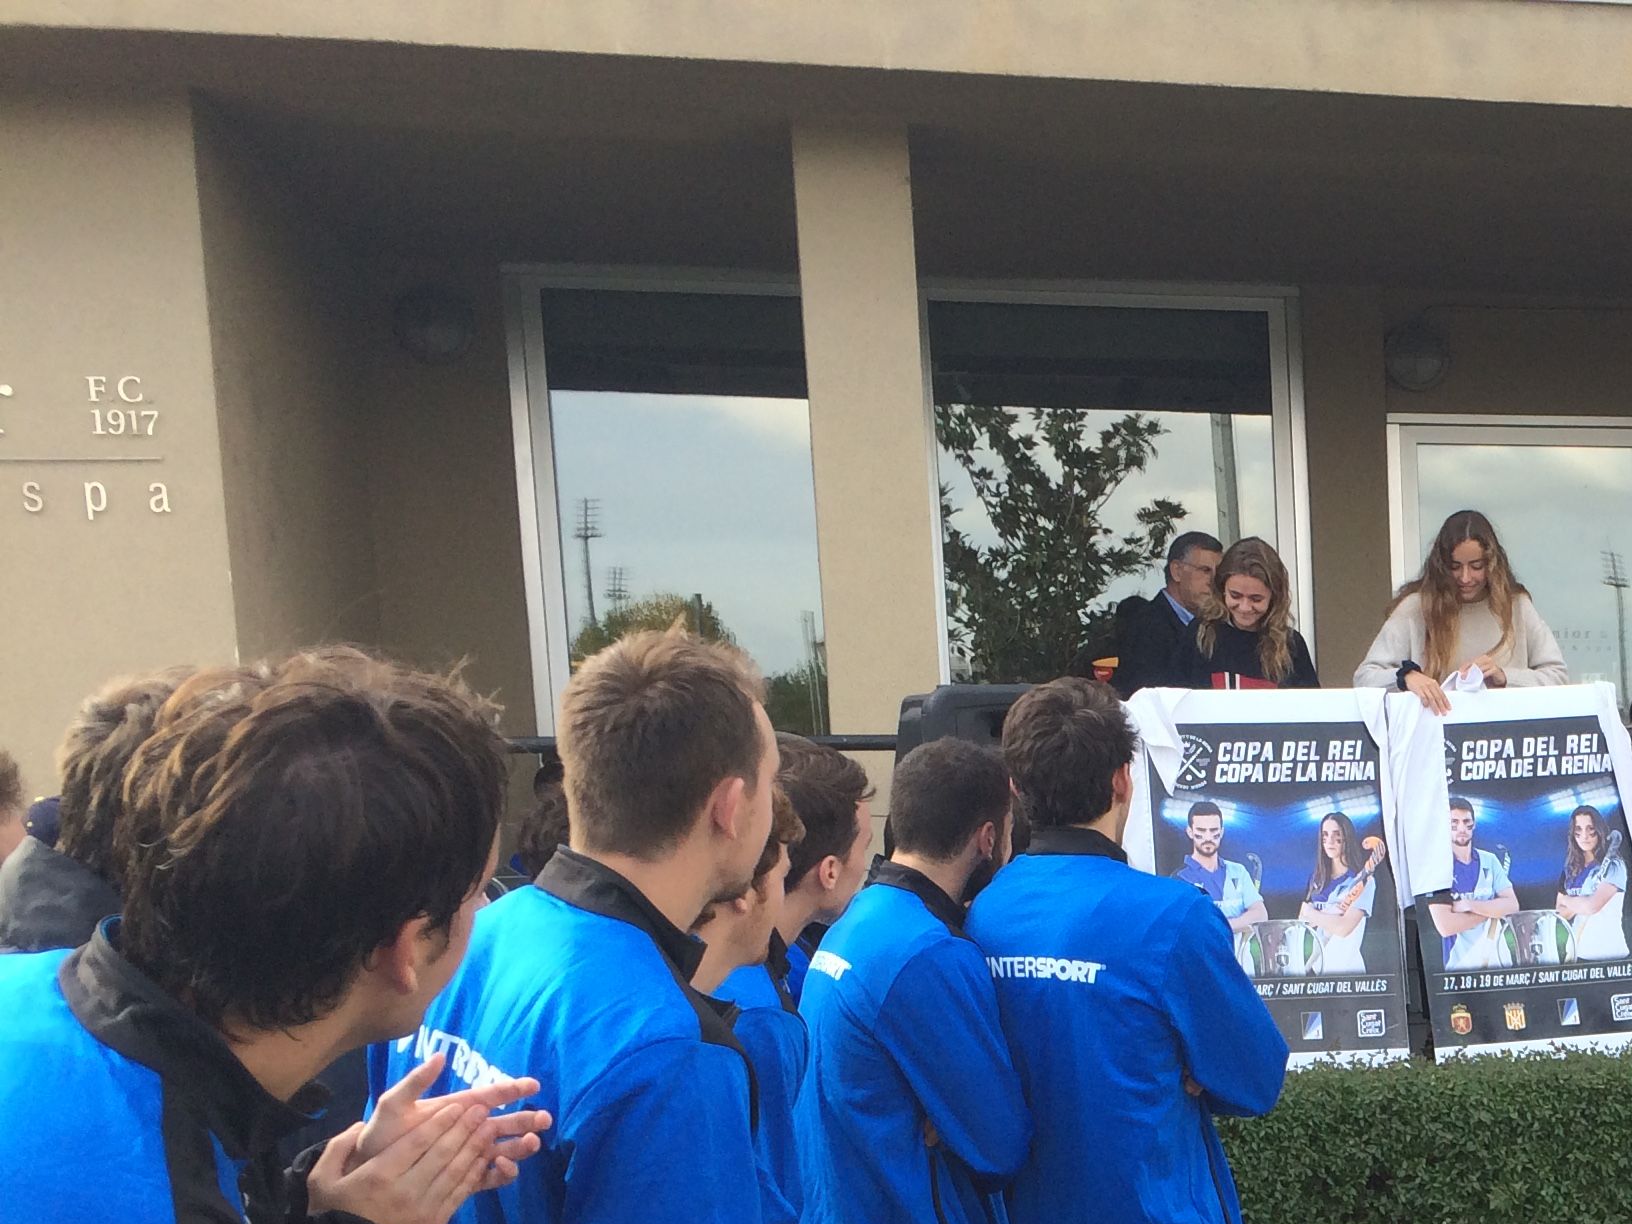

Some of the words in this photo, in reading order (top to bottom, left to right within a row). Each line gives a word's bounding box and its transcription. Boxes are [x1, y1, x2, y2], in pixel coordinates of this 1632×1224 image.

[90, 409, 159, 436] 1917
[1217, 741, 1274, 762] COPA
[1282, 740, 1320, 761] DEL
[1328, 739, 1363, 760] REI
[1462, 739, 1515, 760] COPA
[1522, 736, 1559, 757] DEL
[1566, 734, 1598, 754] REI
[1215, 763, 1265, 783] COPA
[1268, 762, 1292, 782] DE
[1295, 762, 1318, 782] LA
[1320, 761, 1376, 781] REINA
[1460, 759, 1507, 781] COPA
[1510, 758, 1533, 778] DE
[1537, 756, 1557, 776] LA
[1561, 753, 1613, 775] REINA
[1282, 983, 1305, 995] SANT
[1306, 982, 1334, 994] CUGAT
[1337, 981, 1352, 993] DEL
[1355, 979, 1387, 992] VALLÈS
[1460, 976, 1472, 989] 18
[1480, 974, 1491, 988] 19
[1493, 976, 1504, 987] DE
[1506, 973, 1530, 987] MARÇ
[1538, 971, 1560, 984] SANT
[1562, 968, 1588, 982] CUGAT
[1590, 967, 1605, 979] DEL
[1361, 1012, 1377, 1021] Sant
